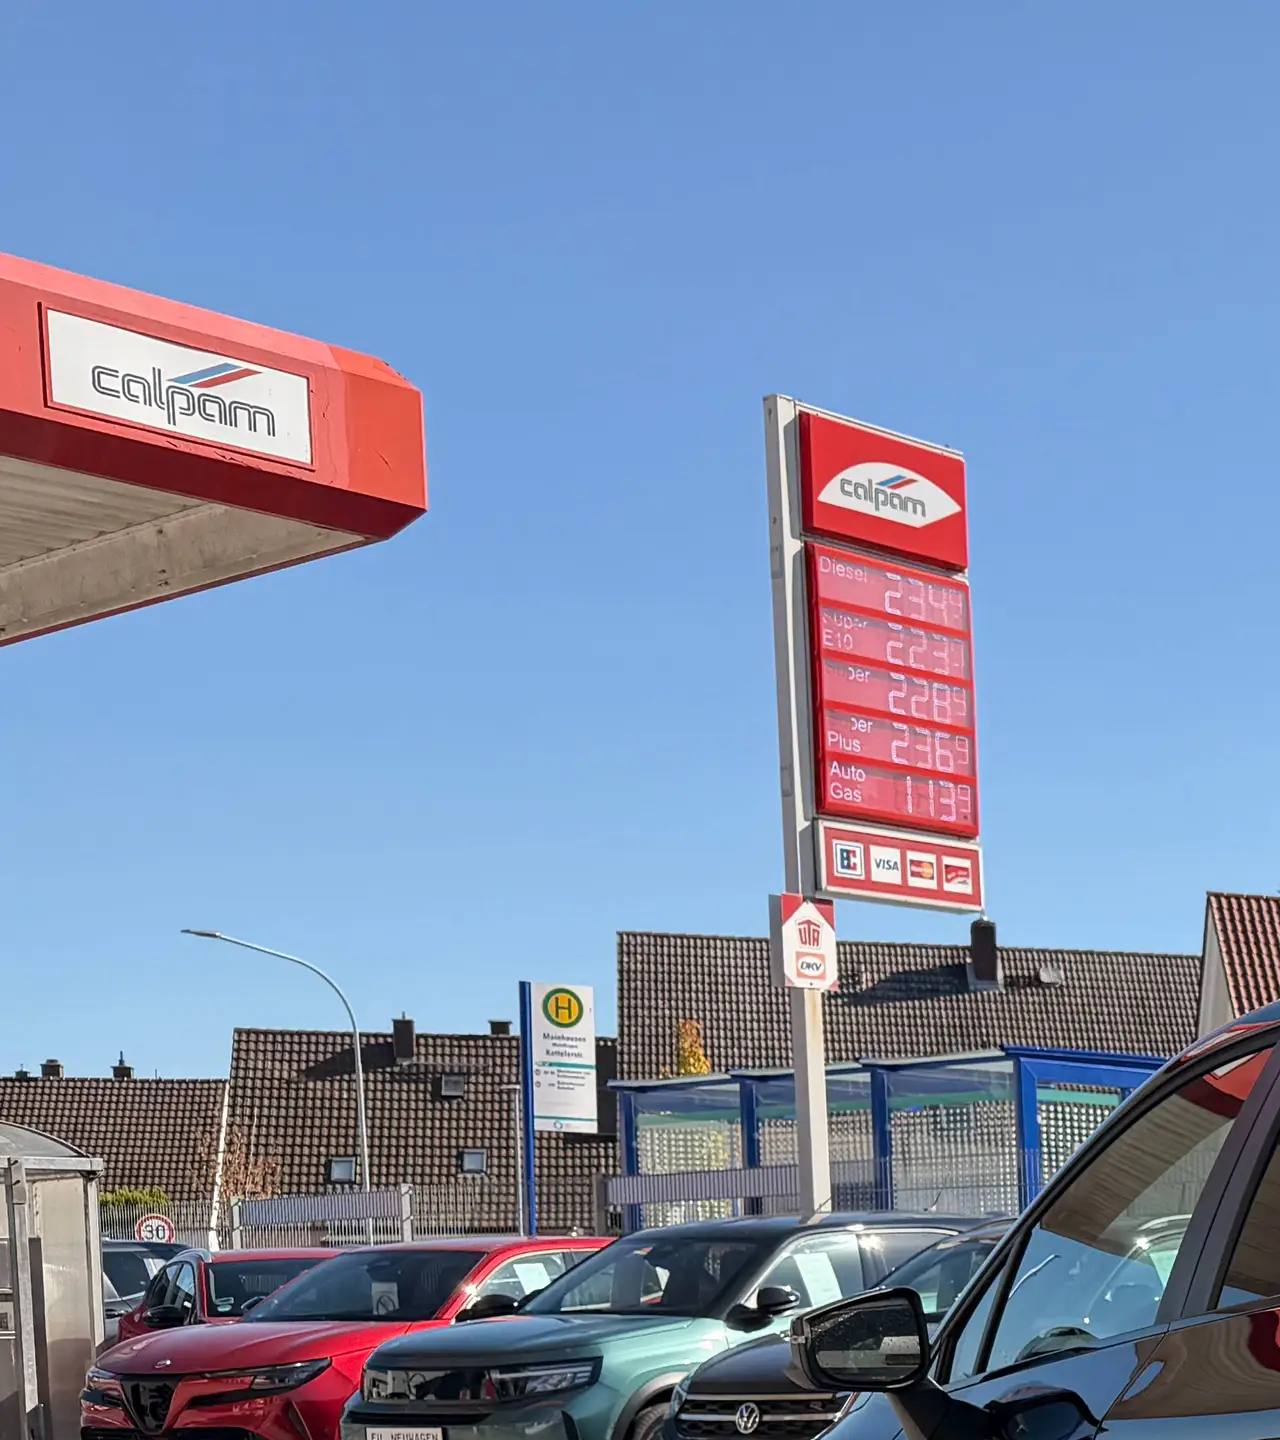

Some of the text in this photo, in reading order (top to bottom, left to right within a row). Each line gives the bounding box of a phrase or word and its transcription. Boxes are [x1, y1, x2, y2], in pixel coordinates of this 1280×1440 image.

[91, 365, 277, 438] calpam
[839, 477, 926, 518] calpam
[819, 556, 868, 583] Diesel
[822, 630, 854, 651] E10
[828, 733, 862, 753] Plus
[830, 761, 866, 782] Auto
[830, 782, 862, 803] Gas
[874, 858, 899, 872] VISA
[798, 920, 820, 947] UTA
[800, 960, 821, 972] DKV
[542, 1033, 586, 1042] Mainhausen
[144, 1225, 166, 1240] 30
